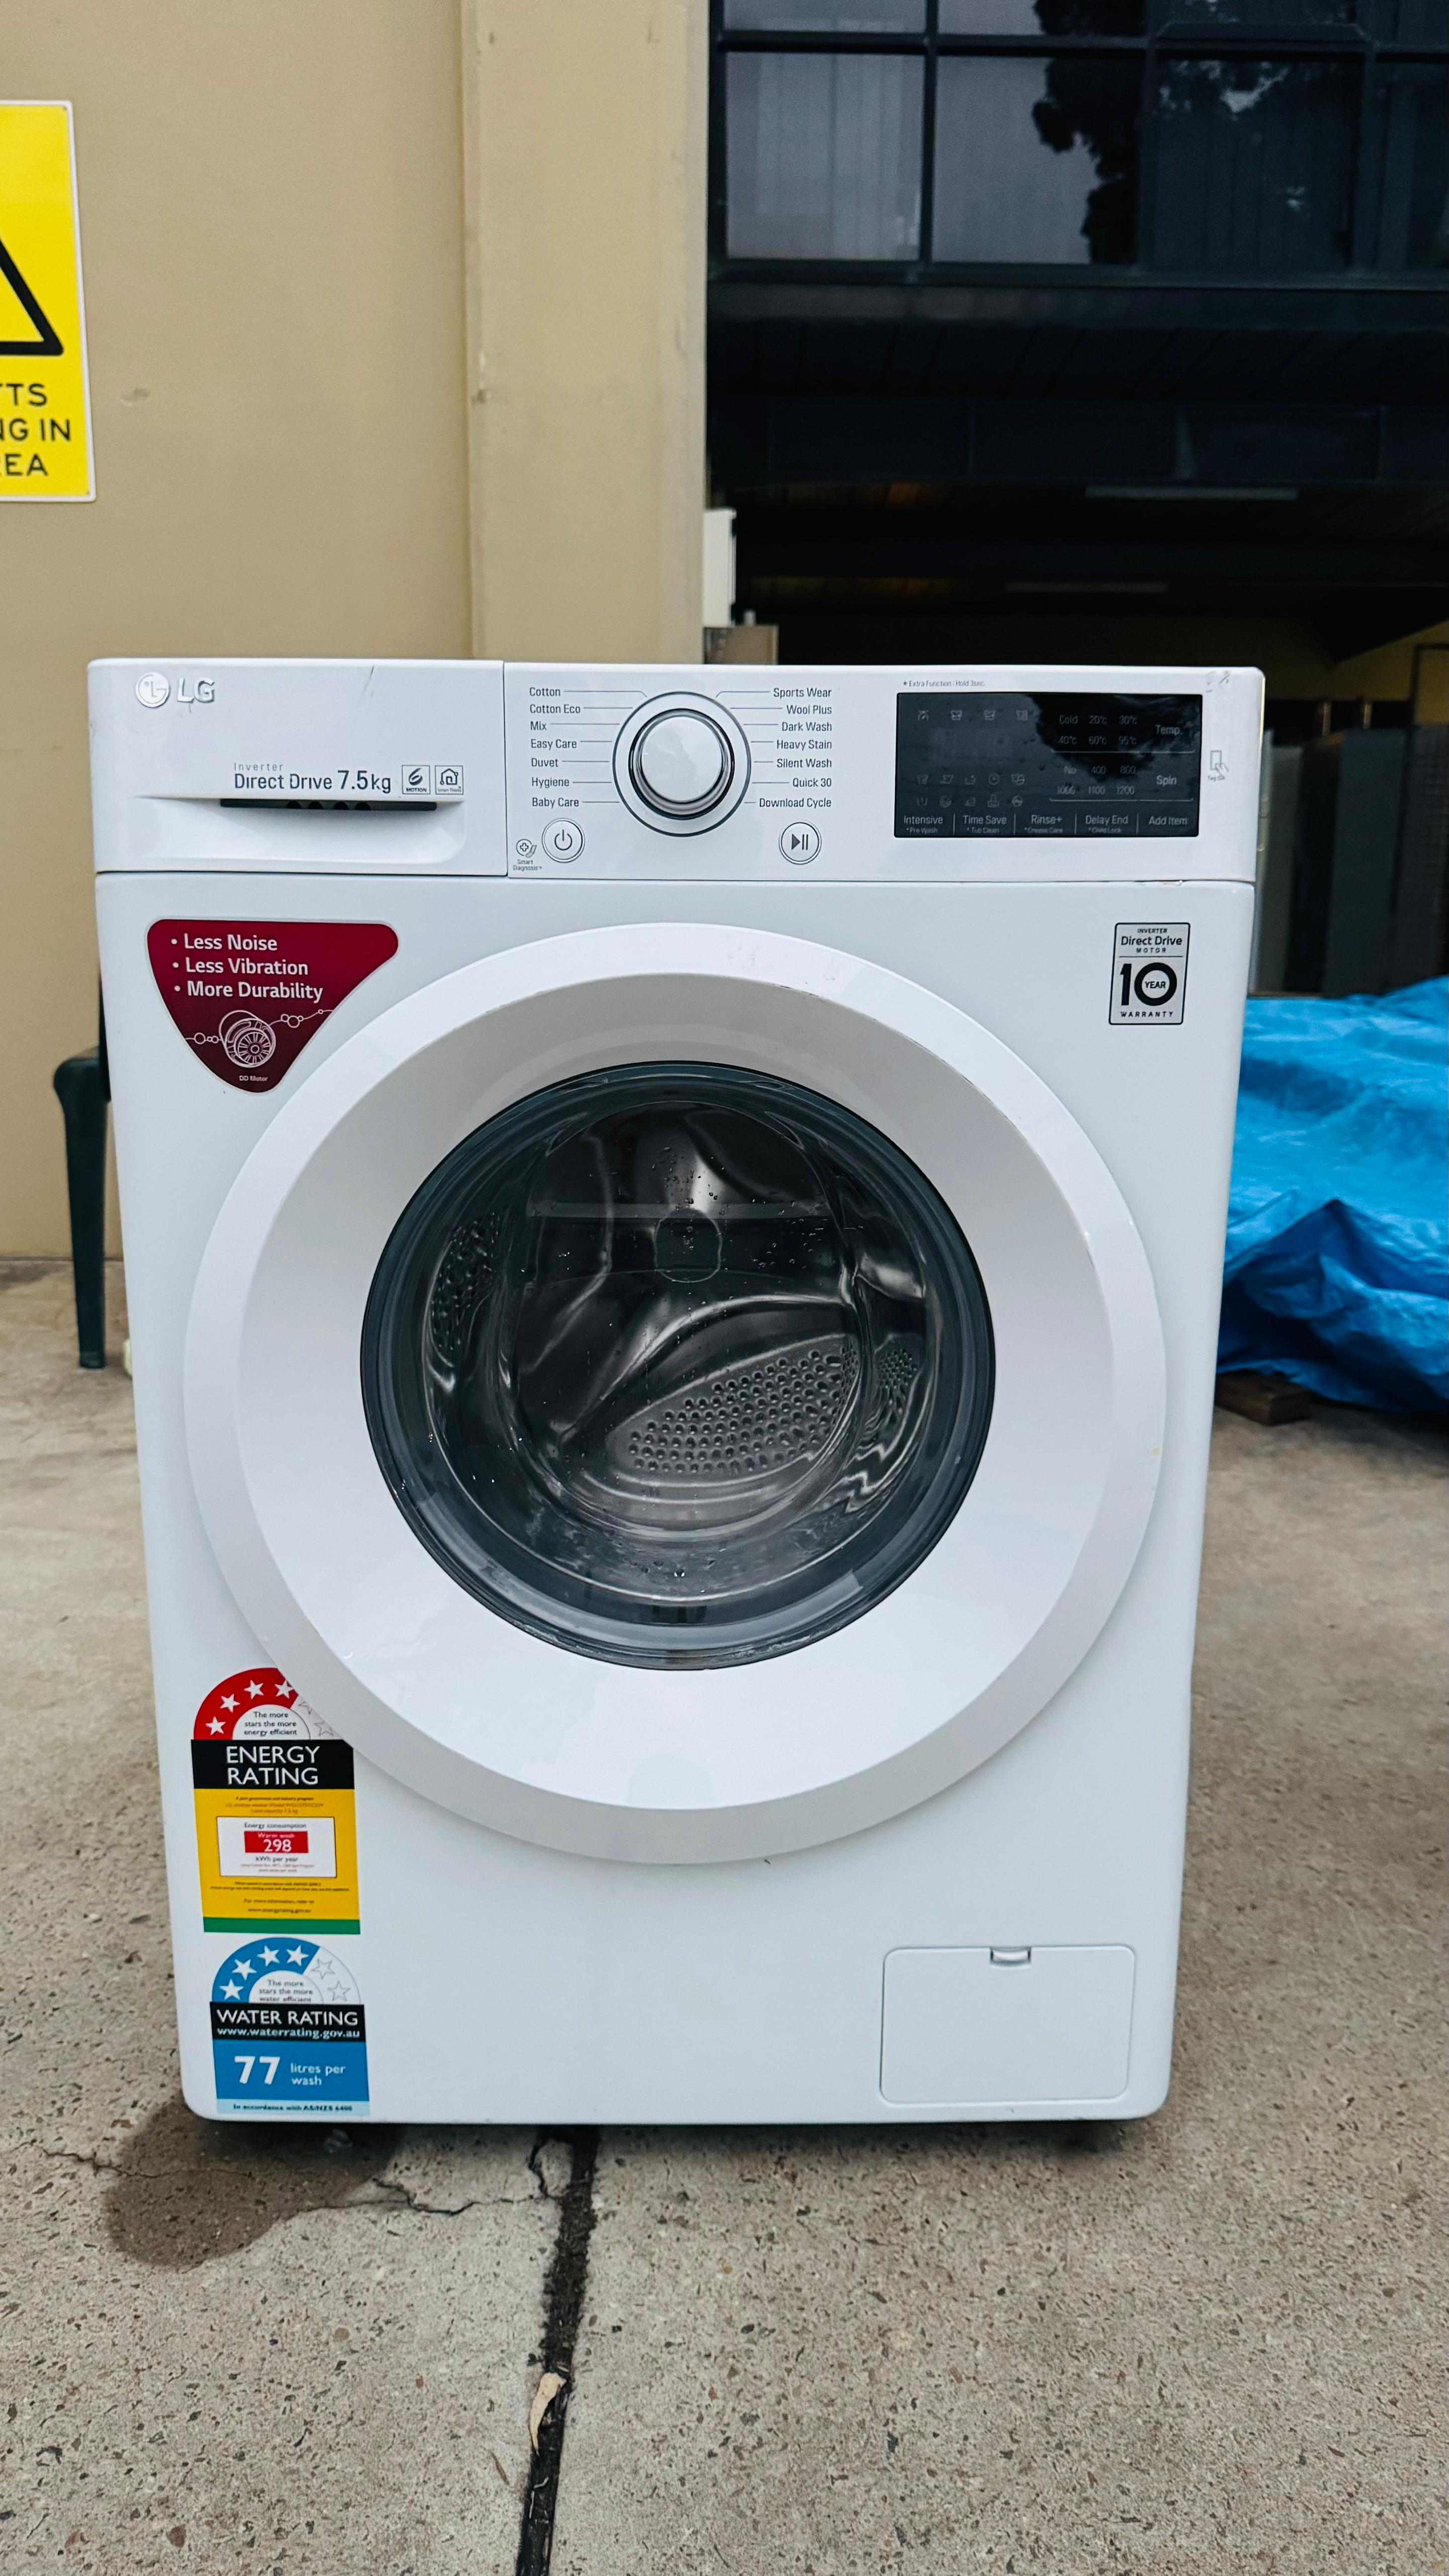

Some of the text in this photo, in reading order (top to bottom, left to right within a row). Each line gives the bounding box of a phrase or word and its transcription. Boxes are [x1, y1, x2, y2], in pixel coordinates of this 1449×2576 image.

[0, 383, 48, 407] TS
[0, 418, 71, 442] G IN
[0, 453, 49, 476] EA
[177, 678, 215, 703] LG
[529, 687, 560, 696] Cotton
[773, 687, 832, 699] Sports Wear
[530, 704, 581, 713] Cotton Eco
[786, 704, 832, 714] Wool Plus
[1059, 715, 1078, 725] Cold
[530, 721, 547, 731] Mix
[782, 721, 832, 732] Dark Wash
[1155, 725, 1182, 736] Temp.
[531, 739, 577, 750] Easy Care
[777, 740, 832, 751] Heavy Stain
[234, 763, 283, 771] Inverter
[531, 758, 558, 767] Duvet
[777, 758, 832, 768] Silent Wash
[234, 773, 284, 789] Direct
[289, 773, 332, 789] Drive
[532, 777, 570, 788] Hygiene
[792, 778, 832, 788] Quick 30
[1157, 775, 1177, 786] Spin
[532, 797, 579, 809] Baby Care
[759, 798, 832, 809] Download Cycle
[904, 815, 943, 825] Intensive
[963, 815, 1007, 825] Time Save
[1031, 815, 1063, 824] Rinse+
[1085, 815, 1129, 826] Delay End
[1149, 816, 1187, 825] Add Item
[184, 933, 277, 951] Less Noise
[1121, 936, 1182, 945] Direct Drive
[185, 957, 308, 975] Less Vibration
[1120, 962, 1177, 1006] 10
[187, 981, 323, 1004] More Durability
[226, 1745, 320, 1763] ENERGY
[228, 1767, 318, 1785] RATING
[263, 1839, 292, 1852] 298
[217, 2009, 358, 2026] WATER RATING
[217, 2027, 360, 2040] www.waterrating.gov.au
[234, 2055, 280, 2085] 77
[290, 2063, 346, 2076] litres per
[291, 2075, 322, 2085] wash
